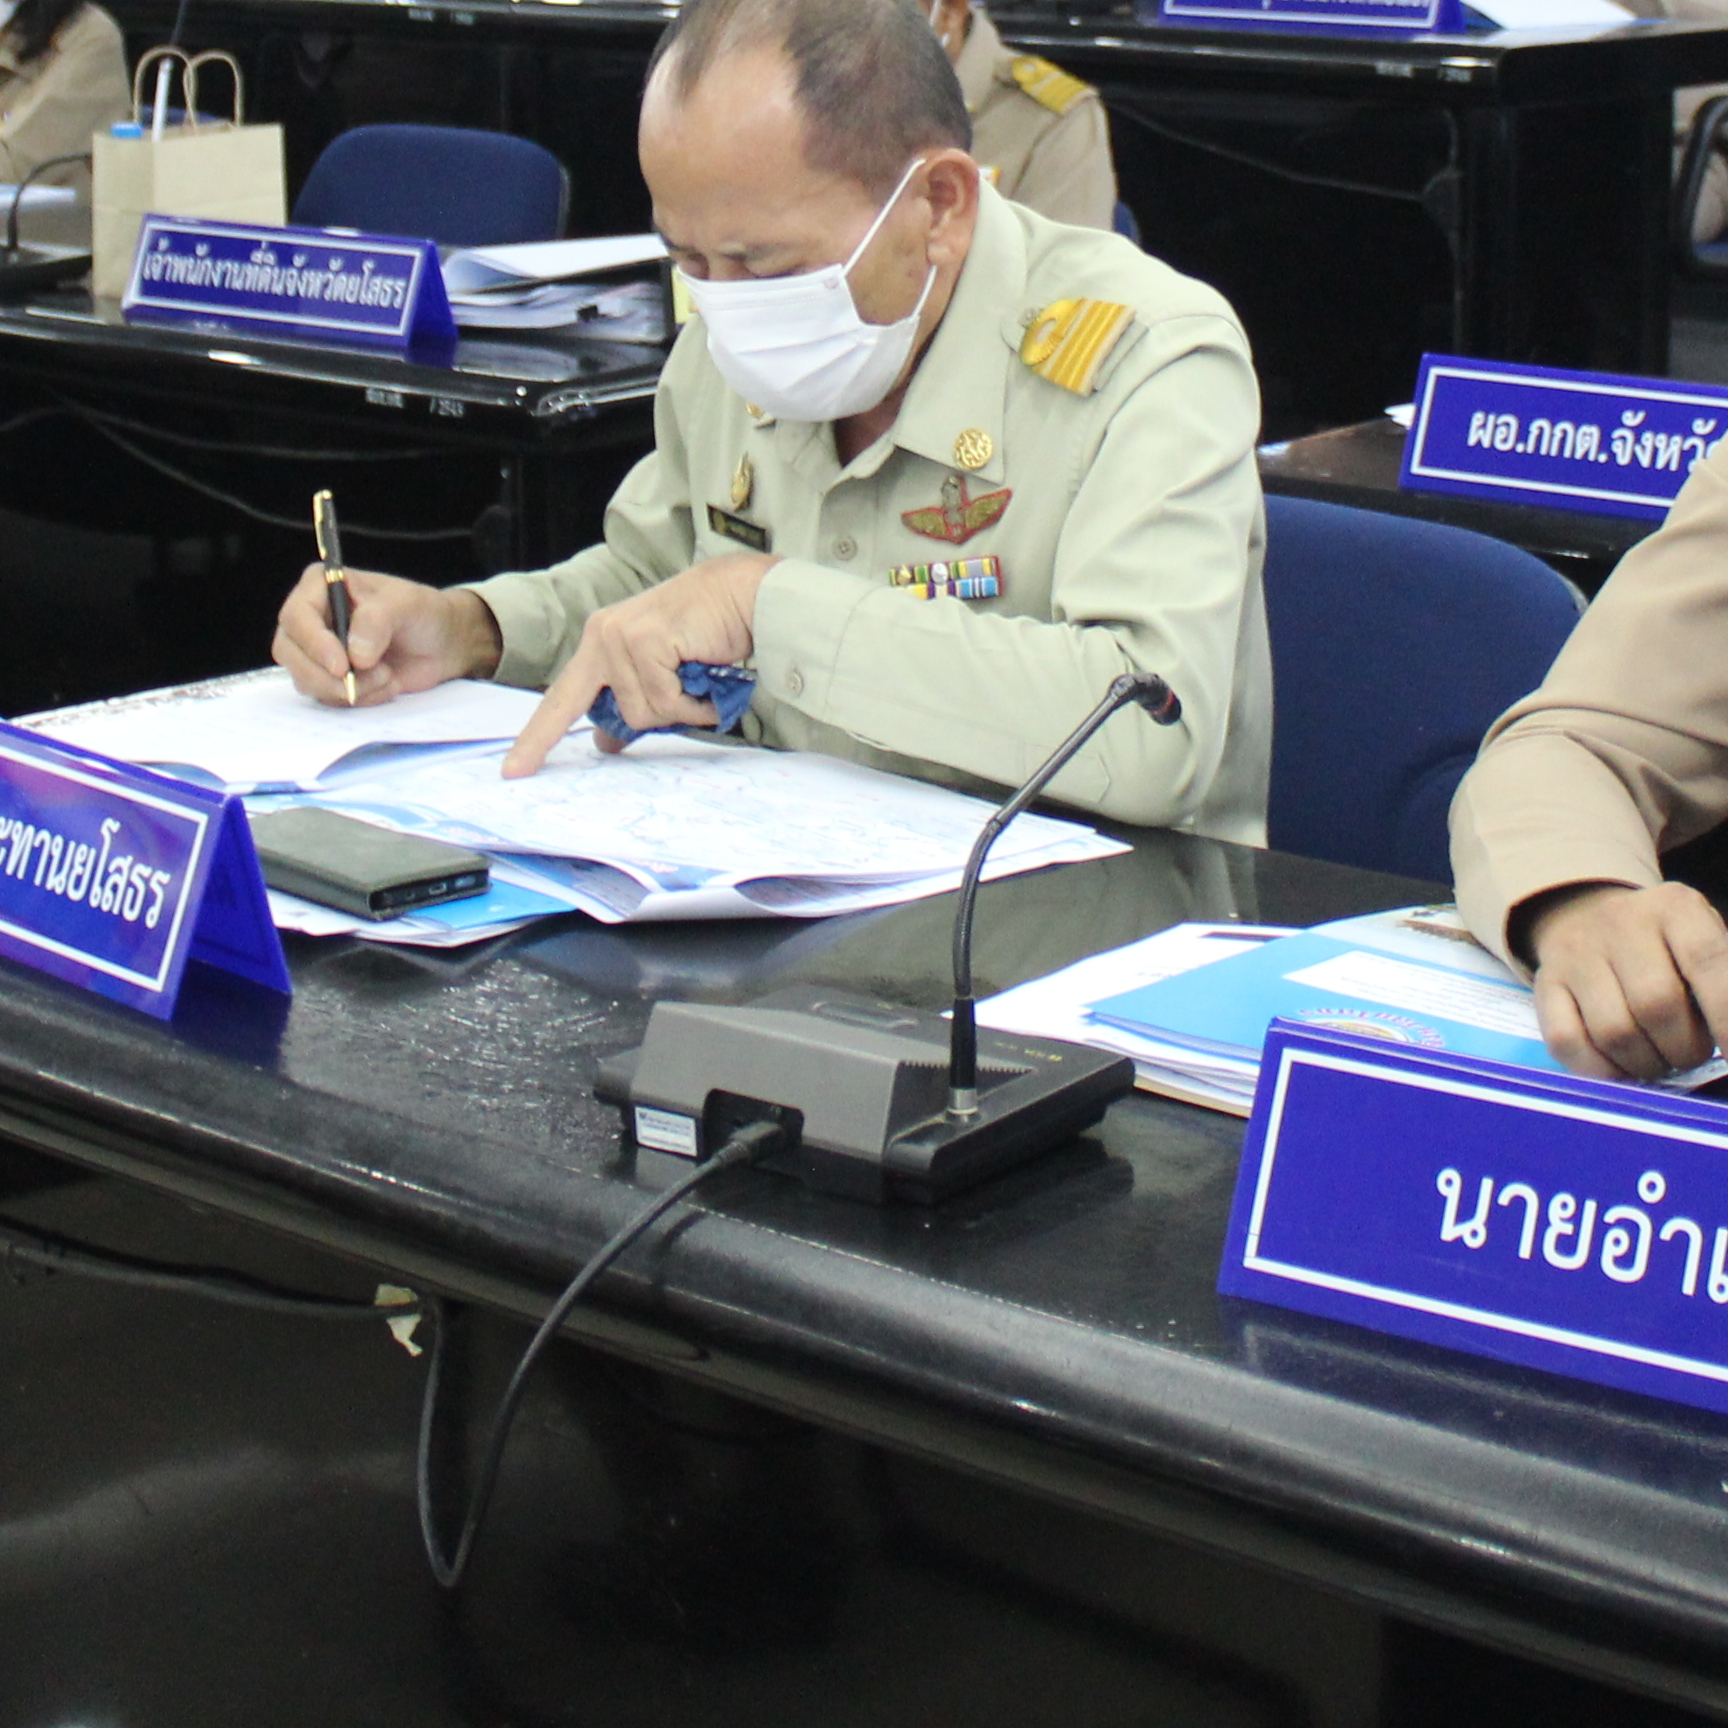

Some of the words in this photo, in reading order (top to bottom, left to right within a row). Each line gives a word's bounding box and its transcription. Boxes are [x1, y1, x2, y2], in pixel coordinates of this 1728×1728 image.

[142, 237, 407, 309] เจ้าพนักงานที่ดินจังหวัดยโสธร
[1467, 409, 1721, 473] ผอ.กกต.จังหวั
